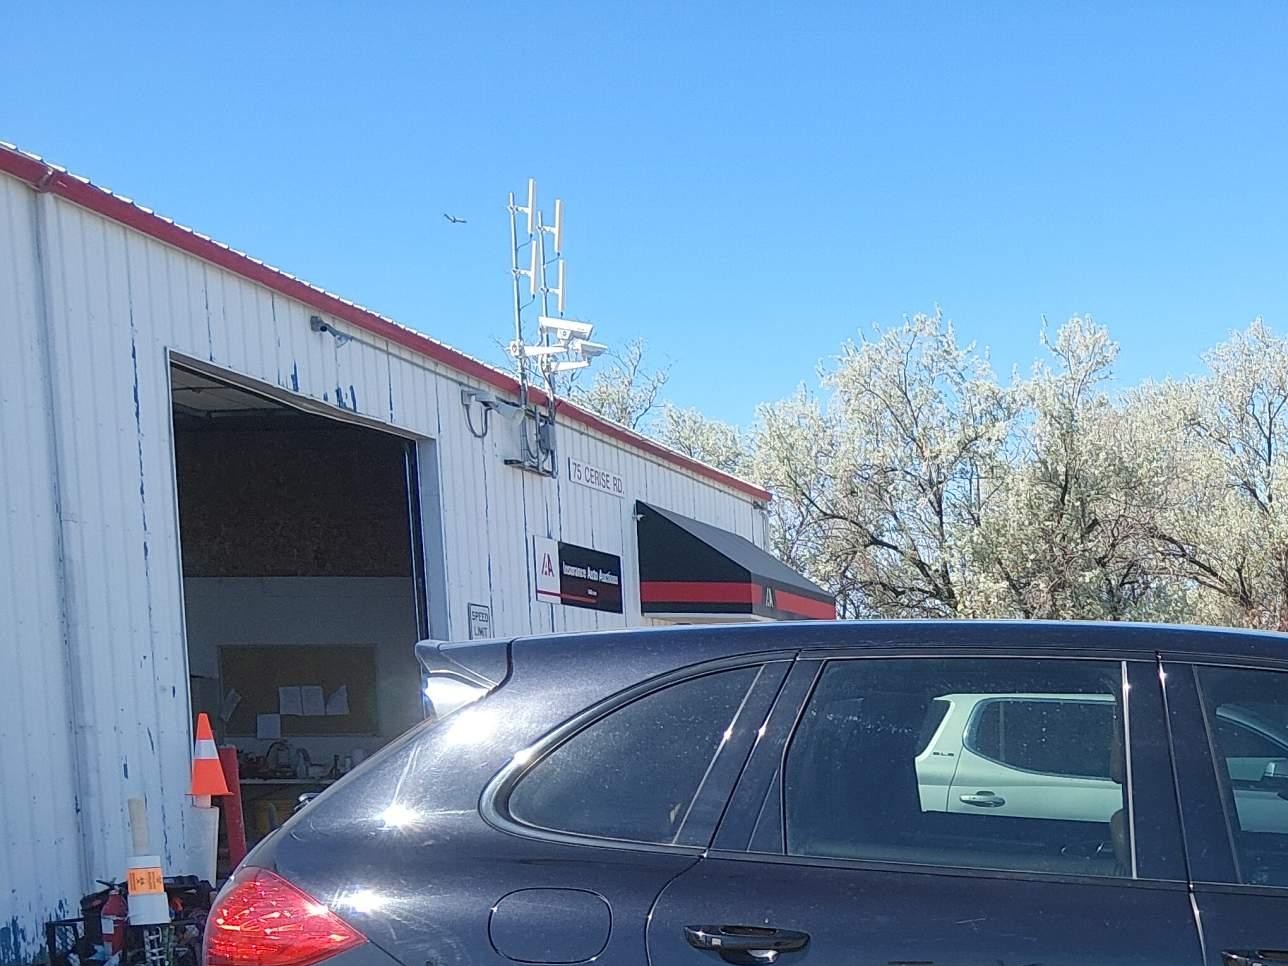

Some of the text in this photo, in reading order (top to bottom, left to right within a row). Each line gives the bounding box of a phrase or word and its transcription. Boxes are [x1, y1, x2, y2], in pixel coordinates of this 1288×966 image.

[572, 462, 625, 495] 75 CERISE RD.
[562, 560, 587, 579] Insurance
[587, 566, 599, 581] Auto
[472, 610, 489, 623] SPEED
